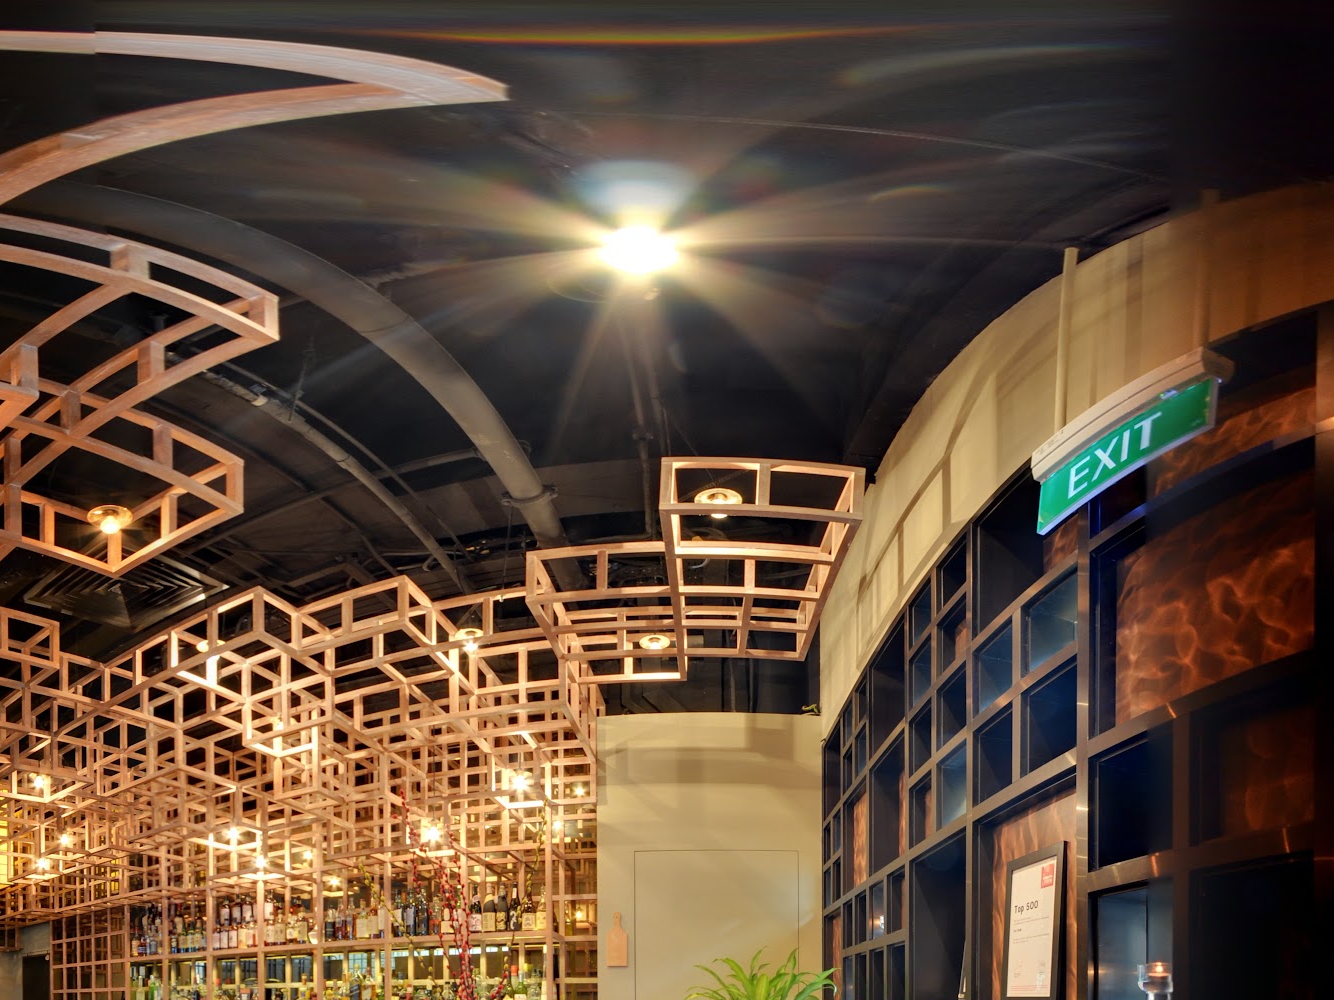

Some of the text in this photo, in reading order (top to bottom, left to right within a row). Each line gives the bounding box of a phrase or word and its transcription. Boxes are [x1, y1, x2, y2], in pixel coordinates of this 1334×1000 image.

[1068, 411, 1162, 499] EXIT
[1014, 900, 1038, 915] Top 500
